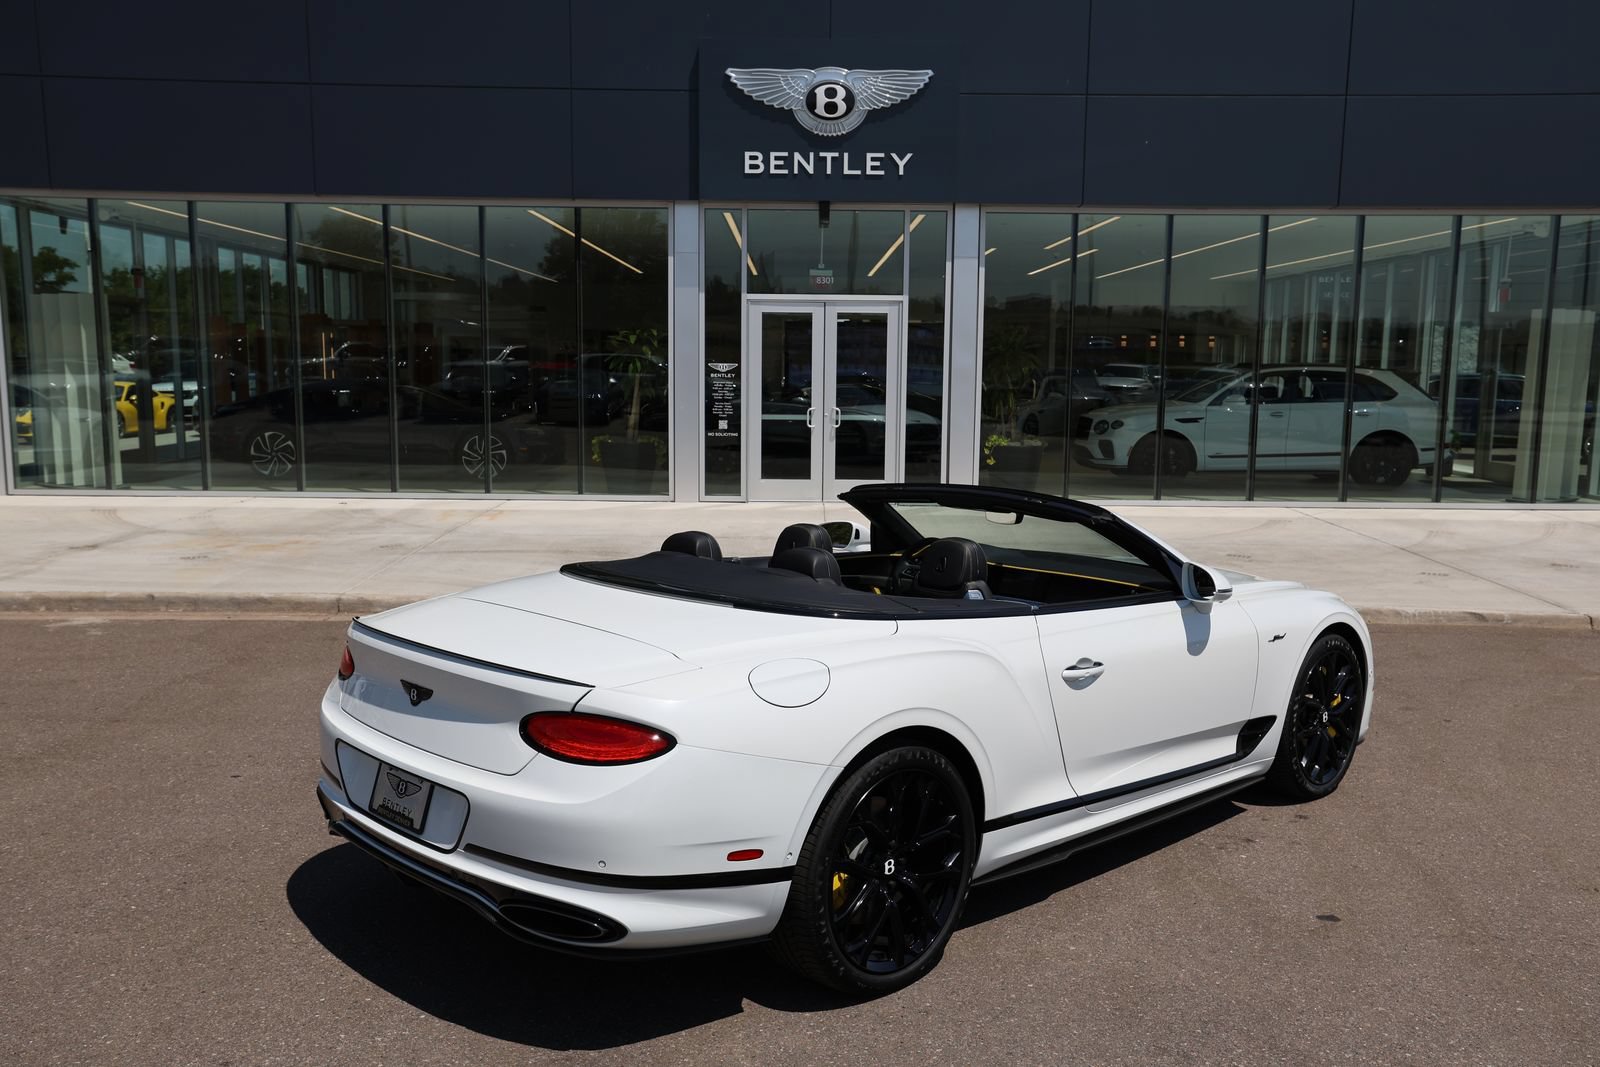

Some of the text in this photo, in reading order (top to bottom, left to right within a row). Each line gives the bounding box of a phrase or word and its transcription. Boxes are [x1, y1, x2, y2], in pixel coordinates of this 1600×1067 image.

[814, 84, 847, 118] B
[744, 151, 913, 176] BENTLEY
[816, 276, 834, 284] 8301
[382, 797, 412, 817] BENTLEY
[884, 859, 895, 875] B
